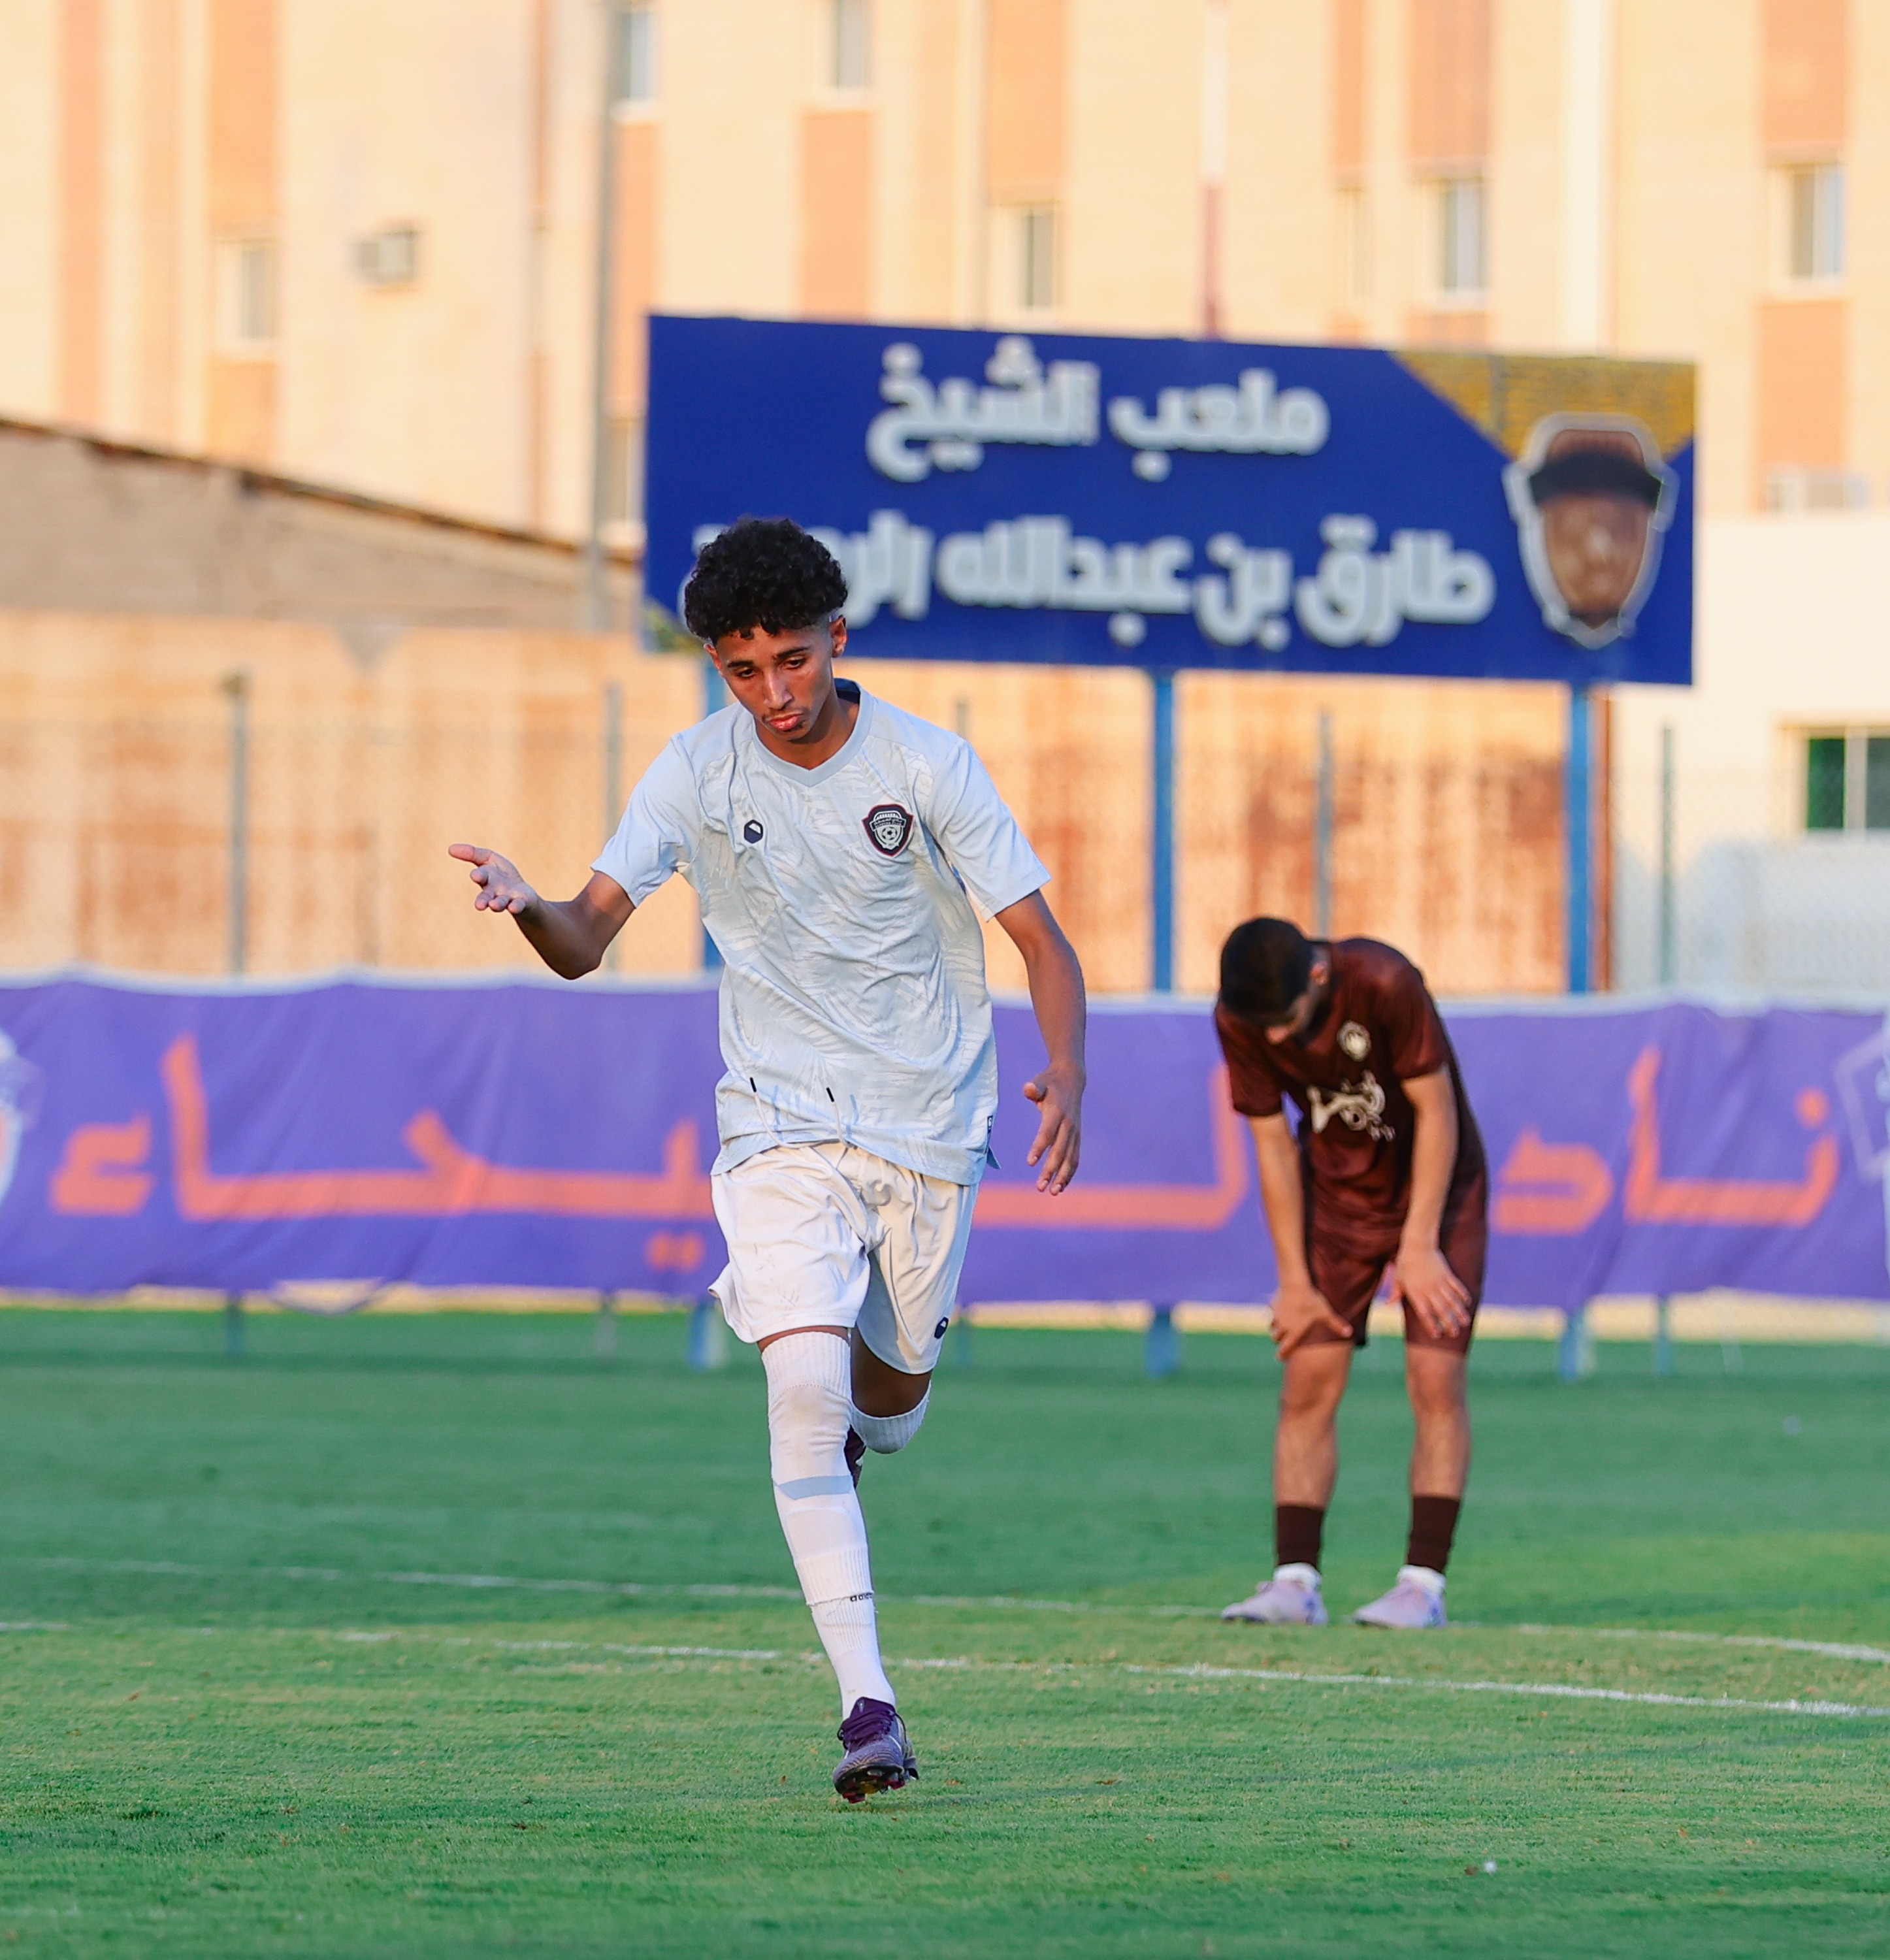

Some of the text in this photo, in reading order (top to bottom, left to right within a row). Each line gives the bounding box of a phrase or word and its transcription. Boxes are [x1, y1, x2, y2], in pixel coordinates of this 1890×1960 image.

[866, 335, 1331, 483] ملعب الشيخ
[936, 514, 1194, 648] عبدالله
[1192, 531, 1294, 651] بن
[1295, 514, 1497, 647] طارق
